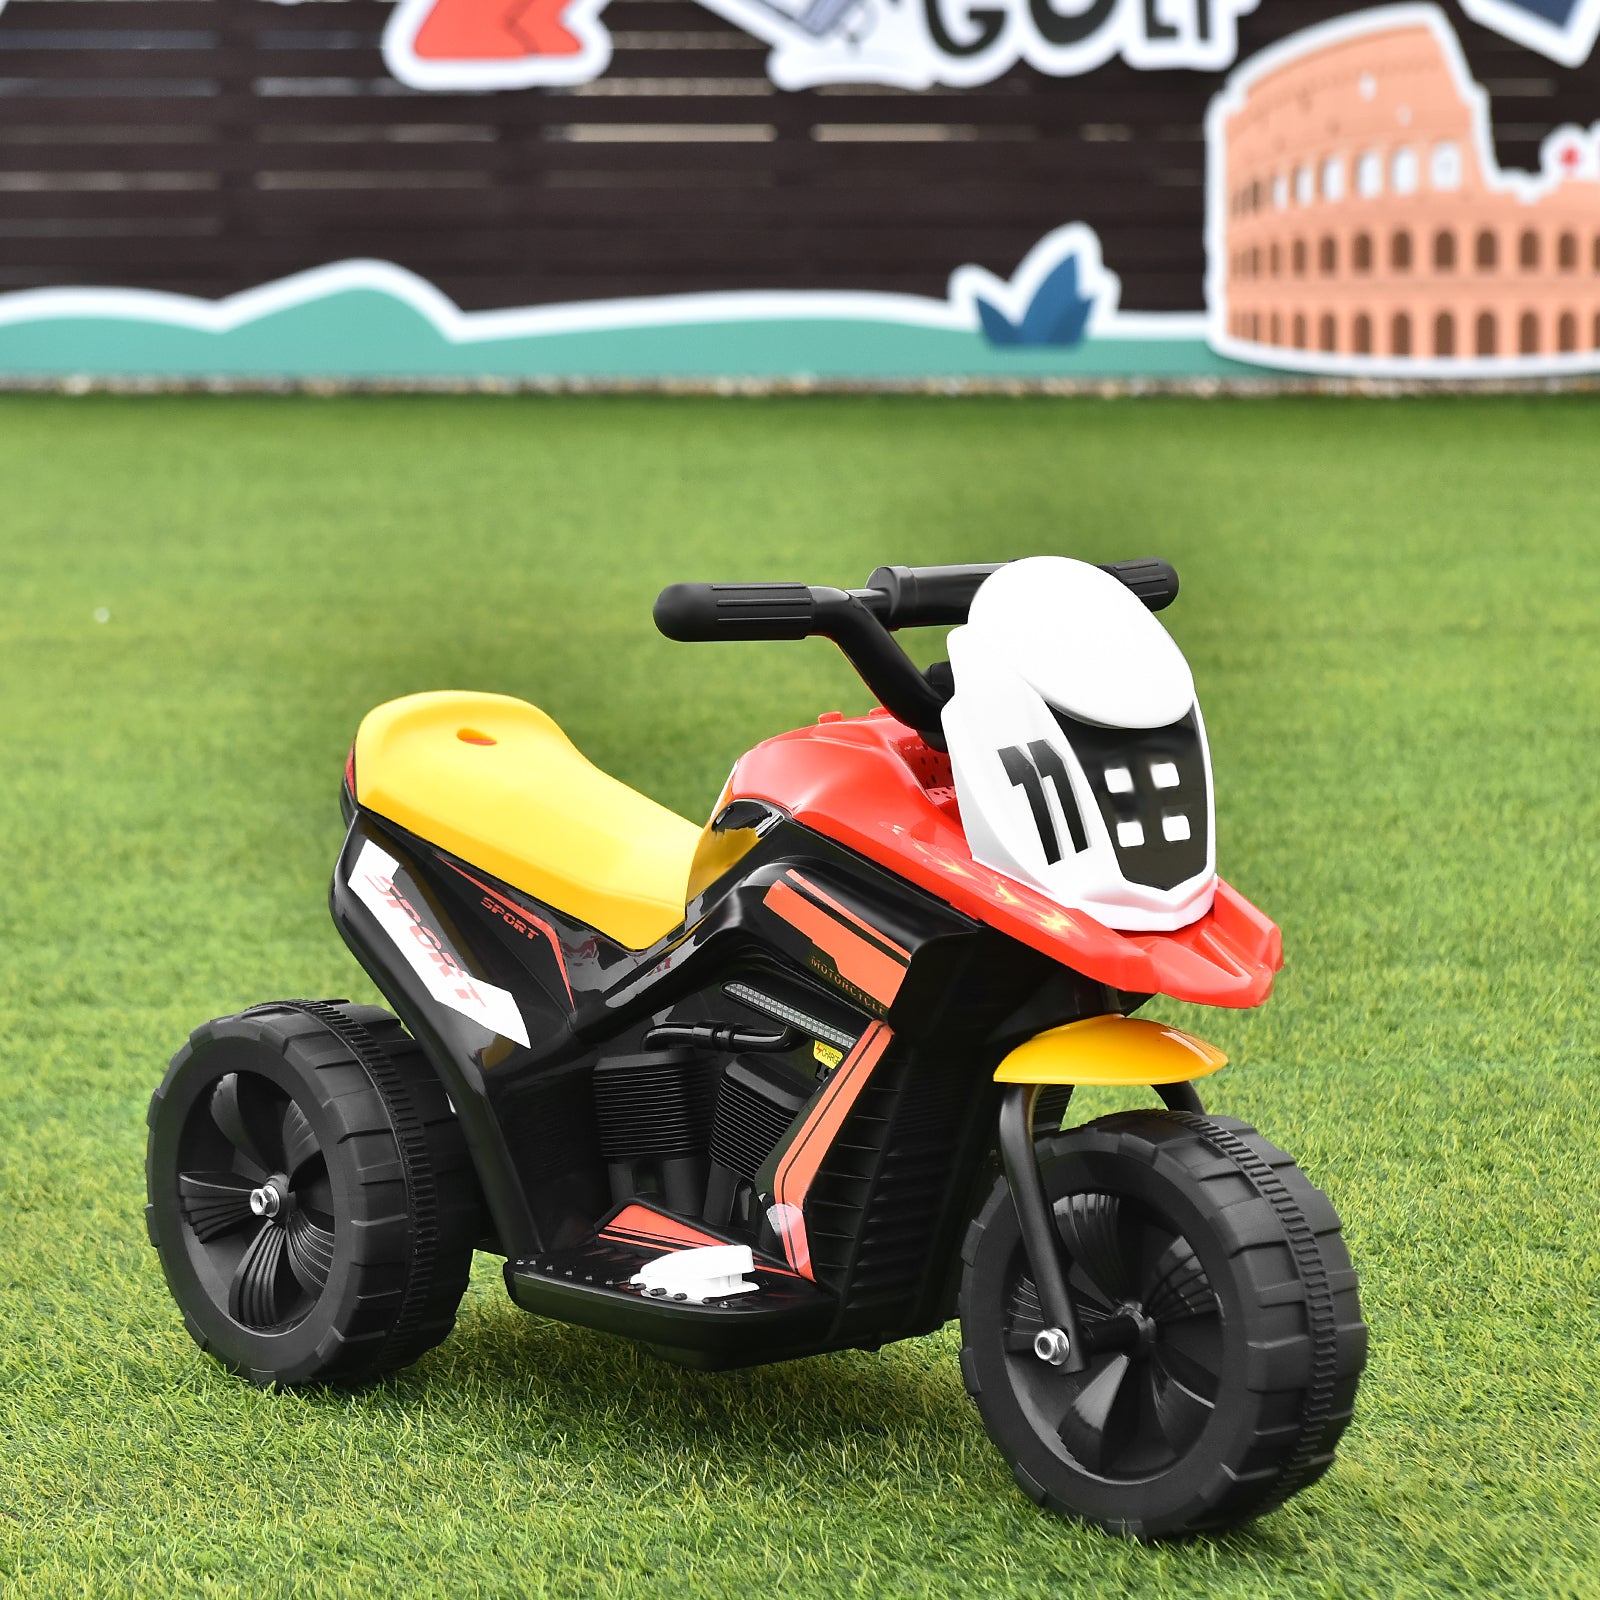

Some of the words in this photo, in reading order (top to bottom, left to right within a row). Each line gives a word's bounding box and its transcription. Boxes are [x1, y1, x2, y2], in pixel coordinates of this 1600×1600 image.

[997, 739, 1091, 866] 11
[364, 874, 487, 1008] SPORT
[480, 896, 539, 940] SPORT
[811, 955, 885, 1016] MOTORCYCLE
